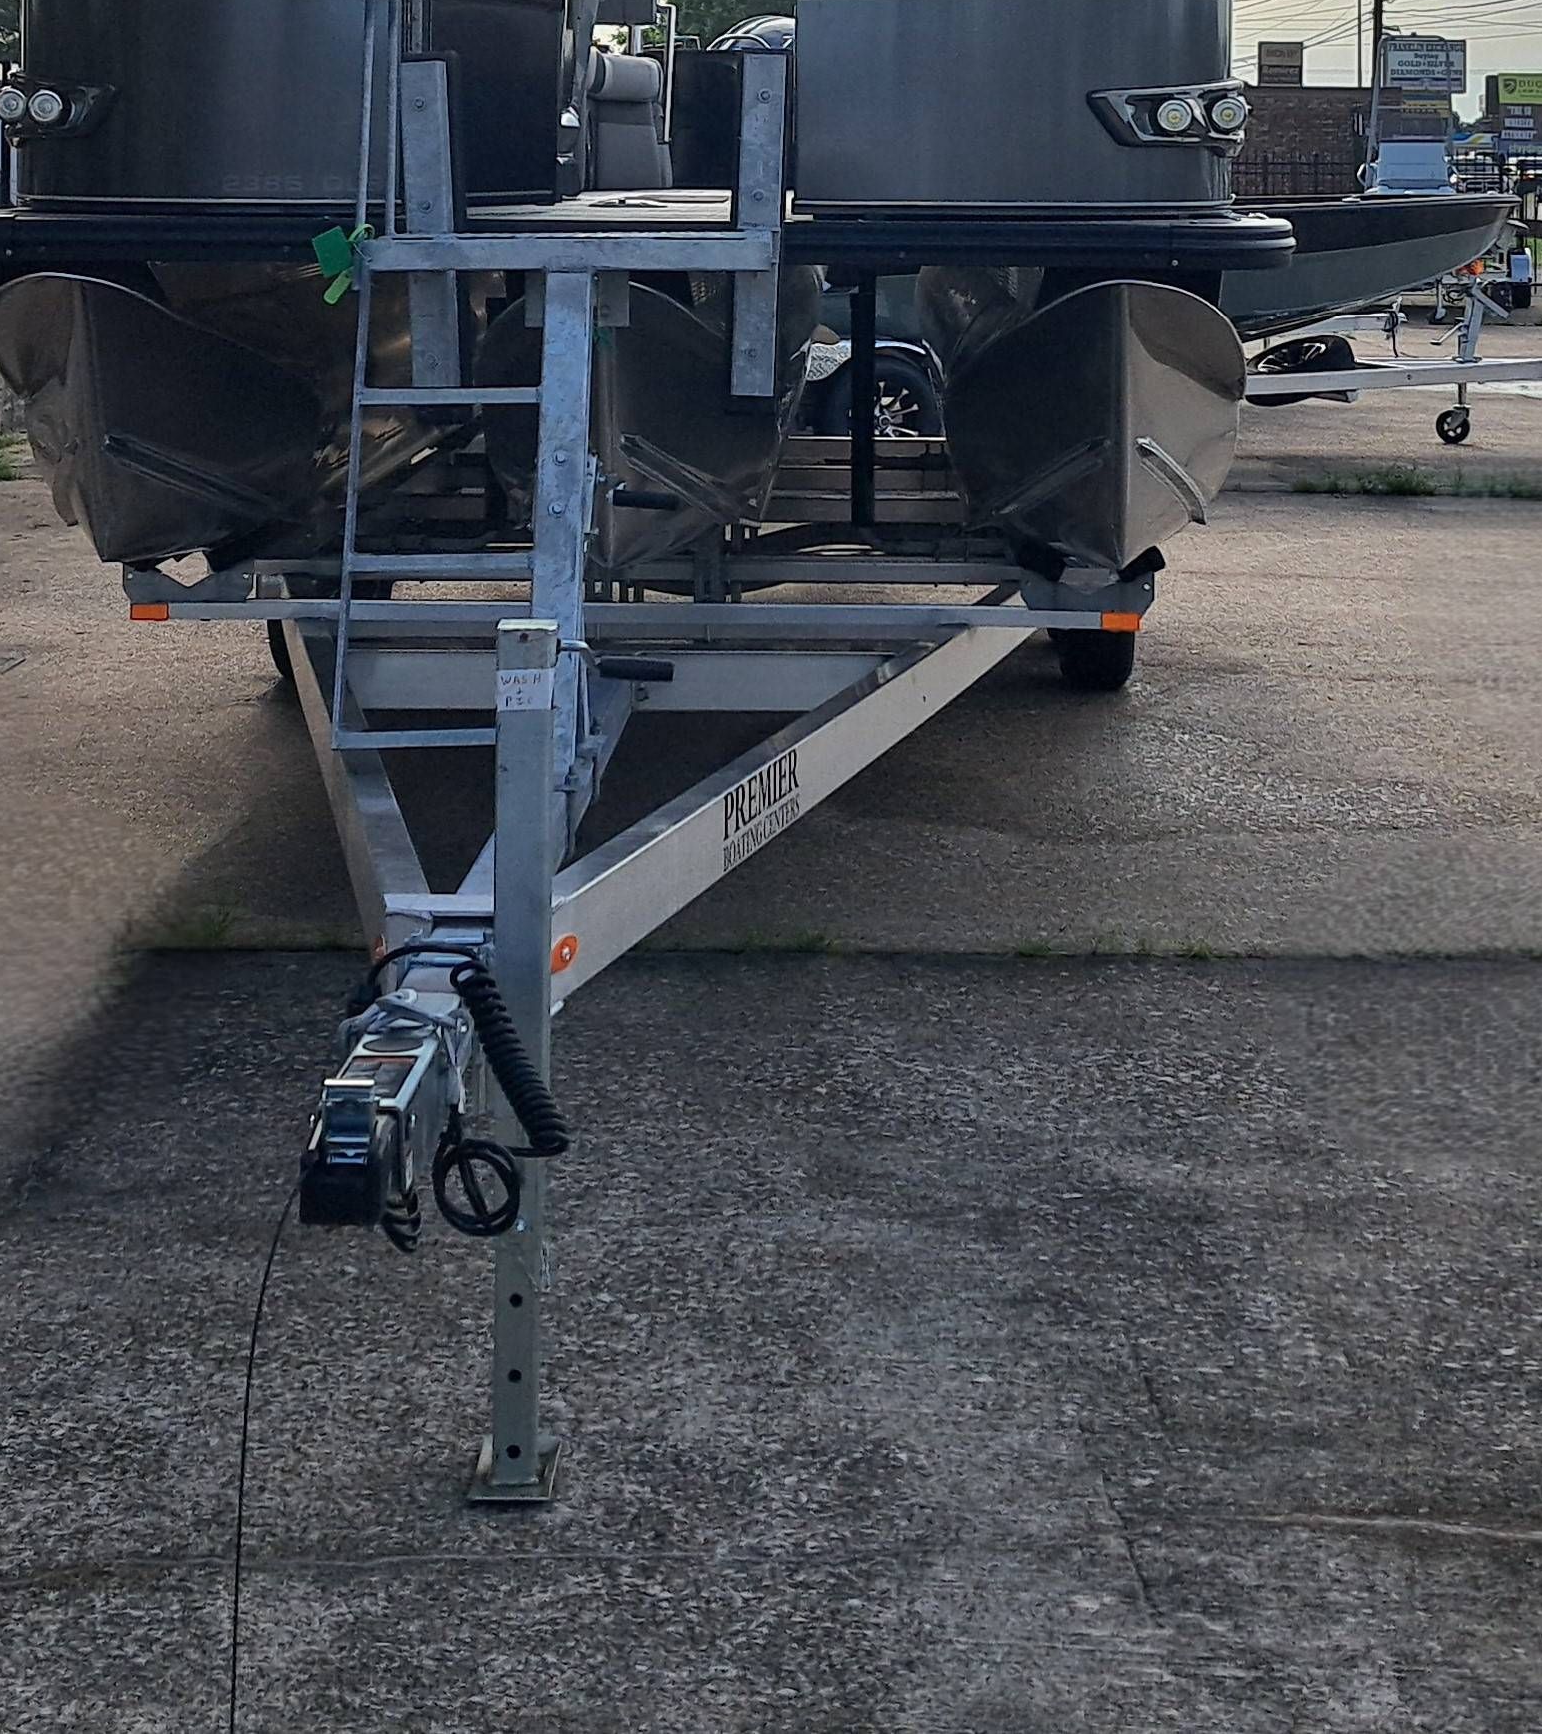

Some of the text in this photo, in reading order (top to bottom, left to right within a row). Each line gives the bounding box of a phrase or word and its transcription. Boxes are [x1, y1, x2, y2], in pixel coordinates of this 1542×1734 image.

[500, 673, 541, 685] WASH
[723, 749, 799, 841] PREMIER
[723, 793, 800, 873] BOATING CENTERS
